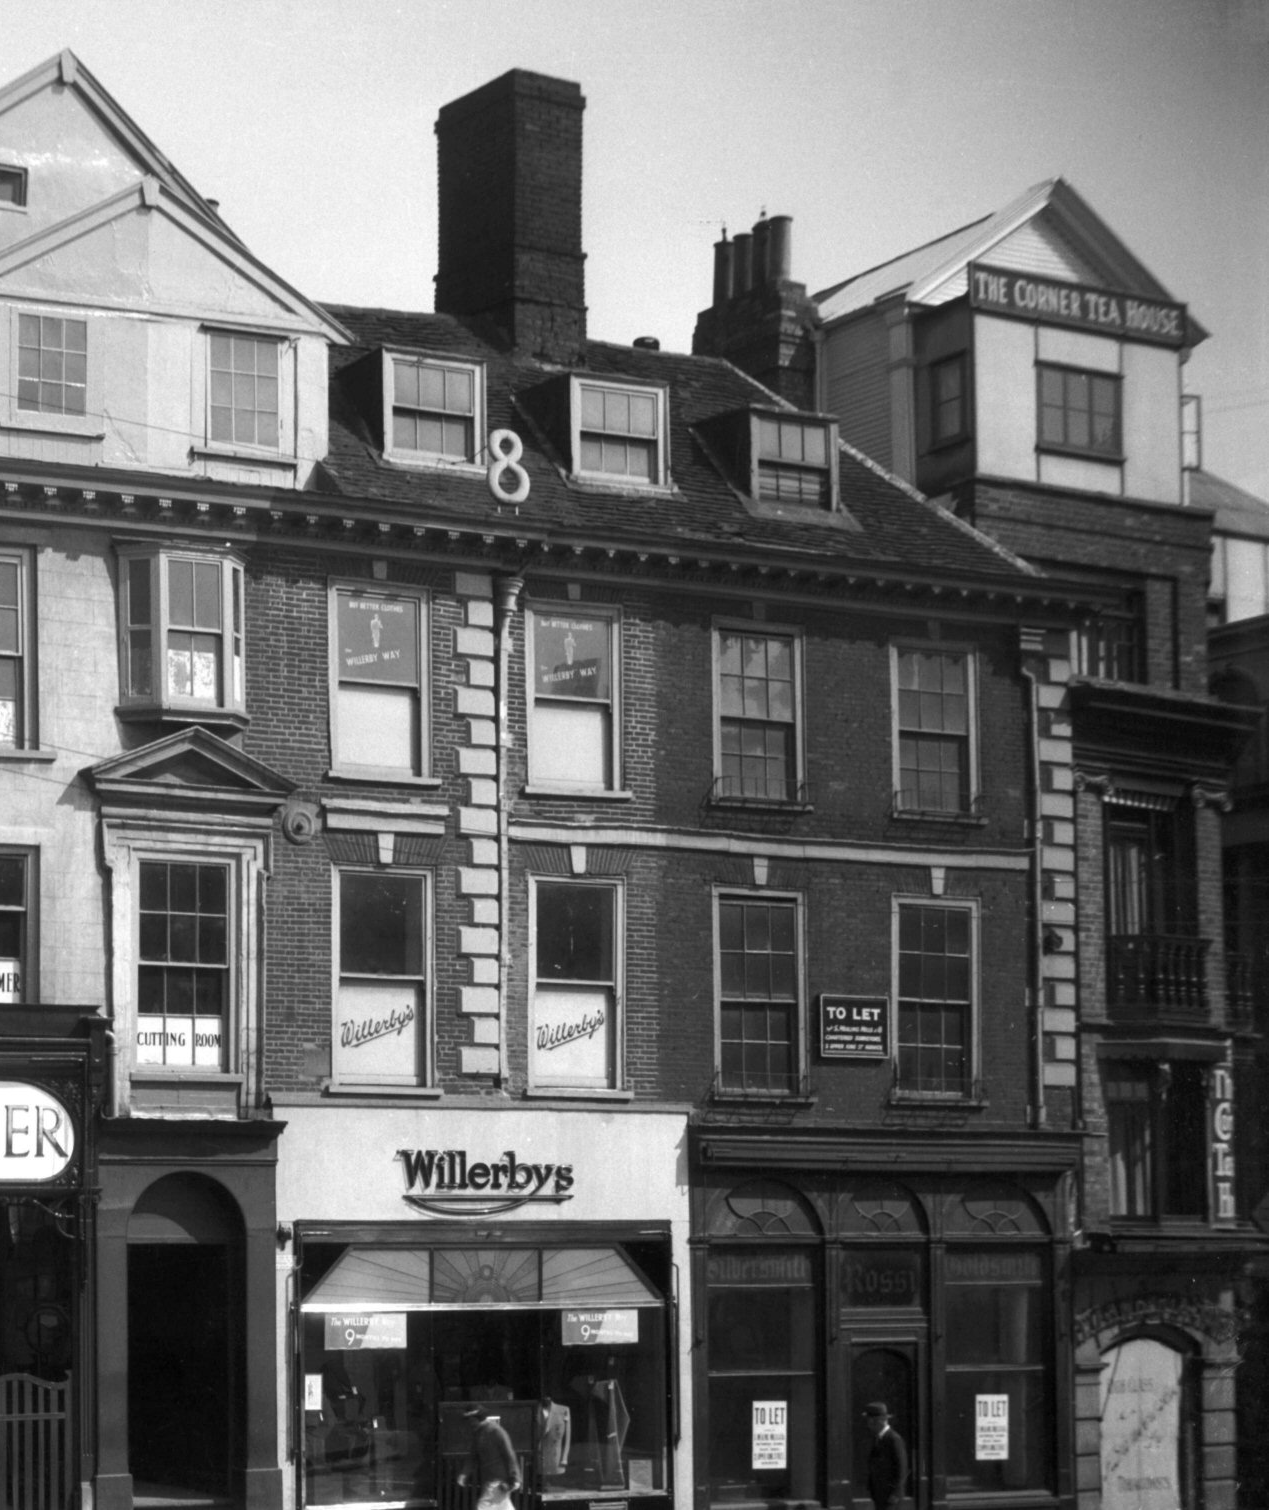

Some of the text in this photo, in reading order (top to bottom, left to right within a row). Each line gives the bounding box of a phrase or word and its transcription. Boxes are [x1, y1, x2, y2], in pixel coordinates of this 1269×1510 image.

[974, 271, 1184, 336] THE CORNER TEA HOUSE
[489, 428, 530, 504] 8
[345, 648, 401, 667] WILLERBY WAY
[541, 665, 597, 683] WILLERBY WAY
[826, 1006, 881, 1021] TO LET
[136, 1030, 222, 1049] CUTTING ROOM
[395, 1148, 575, 1208] Willerbys
[344, 1328, 356, 1346] 9
[580, 1324, 591, 1341] 9
[754, 1406, 786, 1425] TO LET
[977, 1399, 1008, 1417] TO LET
